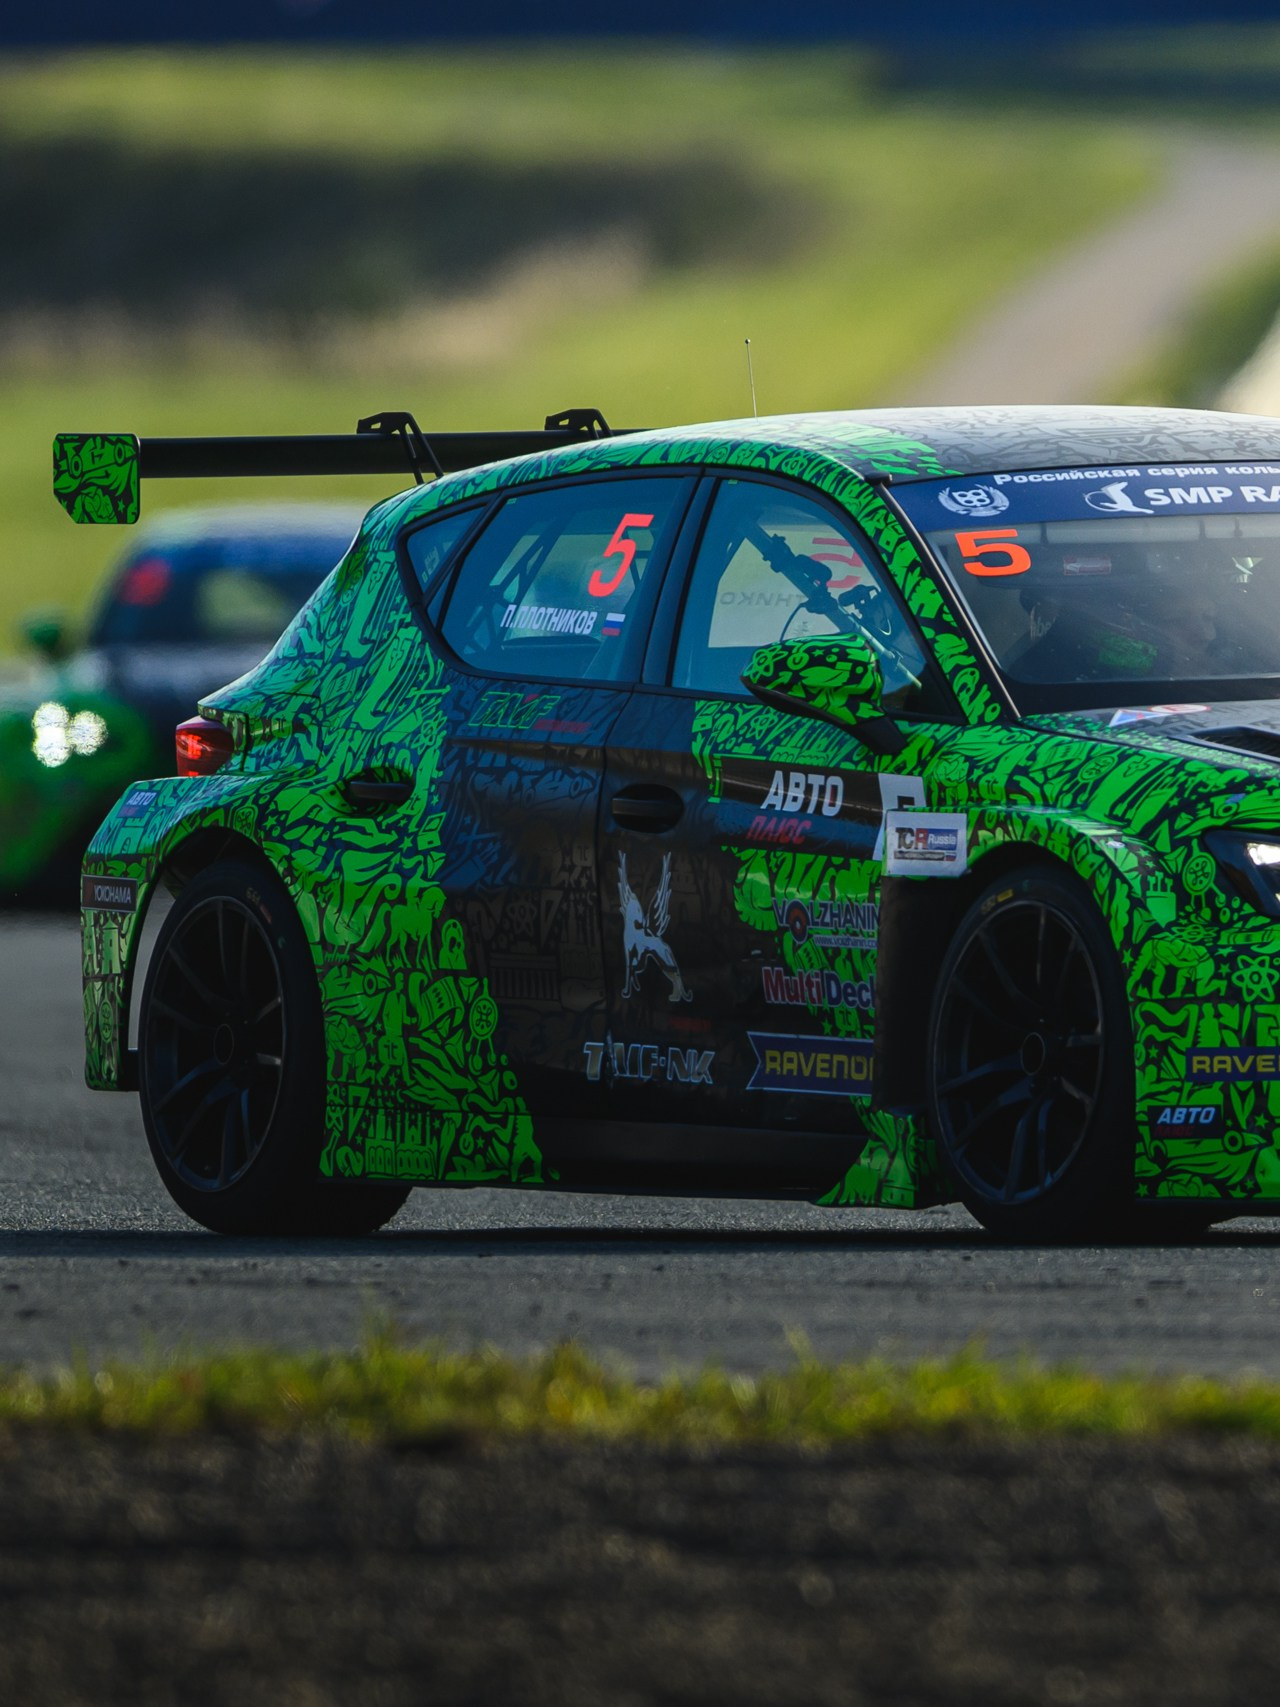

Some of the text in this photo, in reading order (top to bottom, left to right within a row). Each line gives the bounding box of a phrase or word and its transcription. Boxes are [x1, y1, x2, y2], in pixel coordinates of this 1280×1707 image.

[993, 468, 1141, 485] Российская
[1147, 466, 1218, 478] серия
[1143, 486, 1233, 506] SMP
[587, 512, 655, 597] 5
[954, 528, 1032, 577] 5
[760, 769, 844, 817] АВТО
[895, 827, 929, 850] TCR
[1156, 1107, 1217, 1125] АВТО
